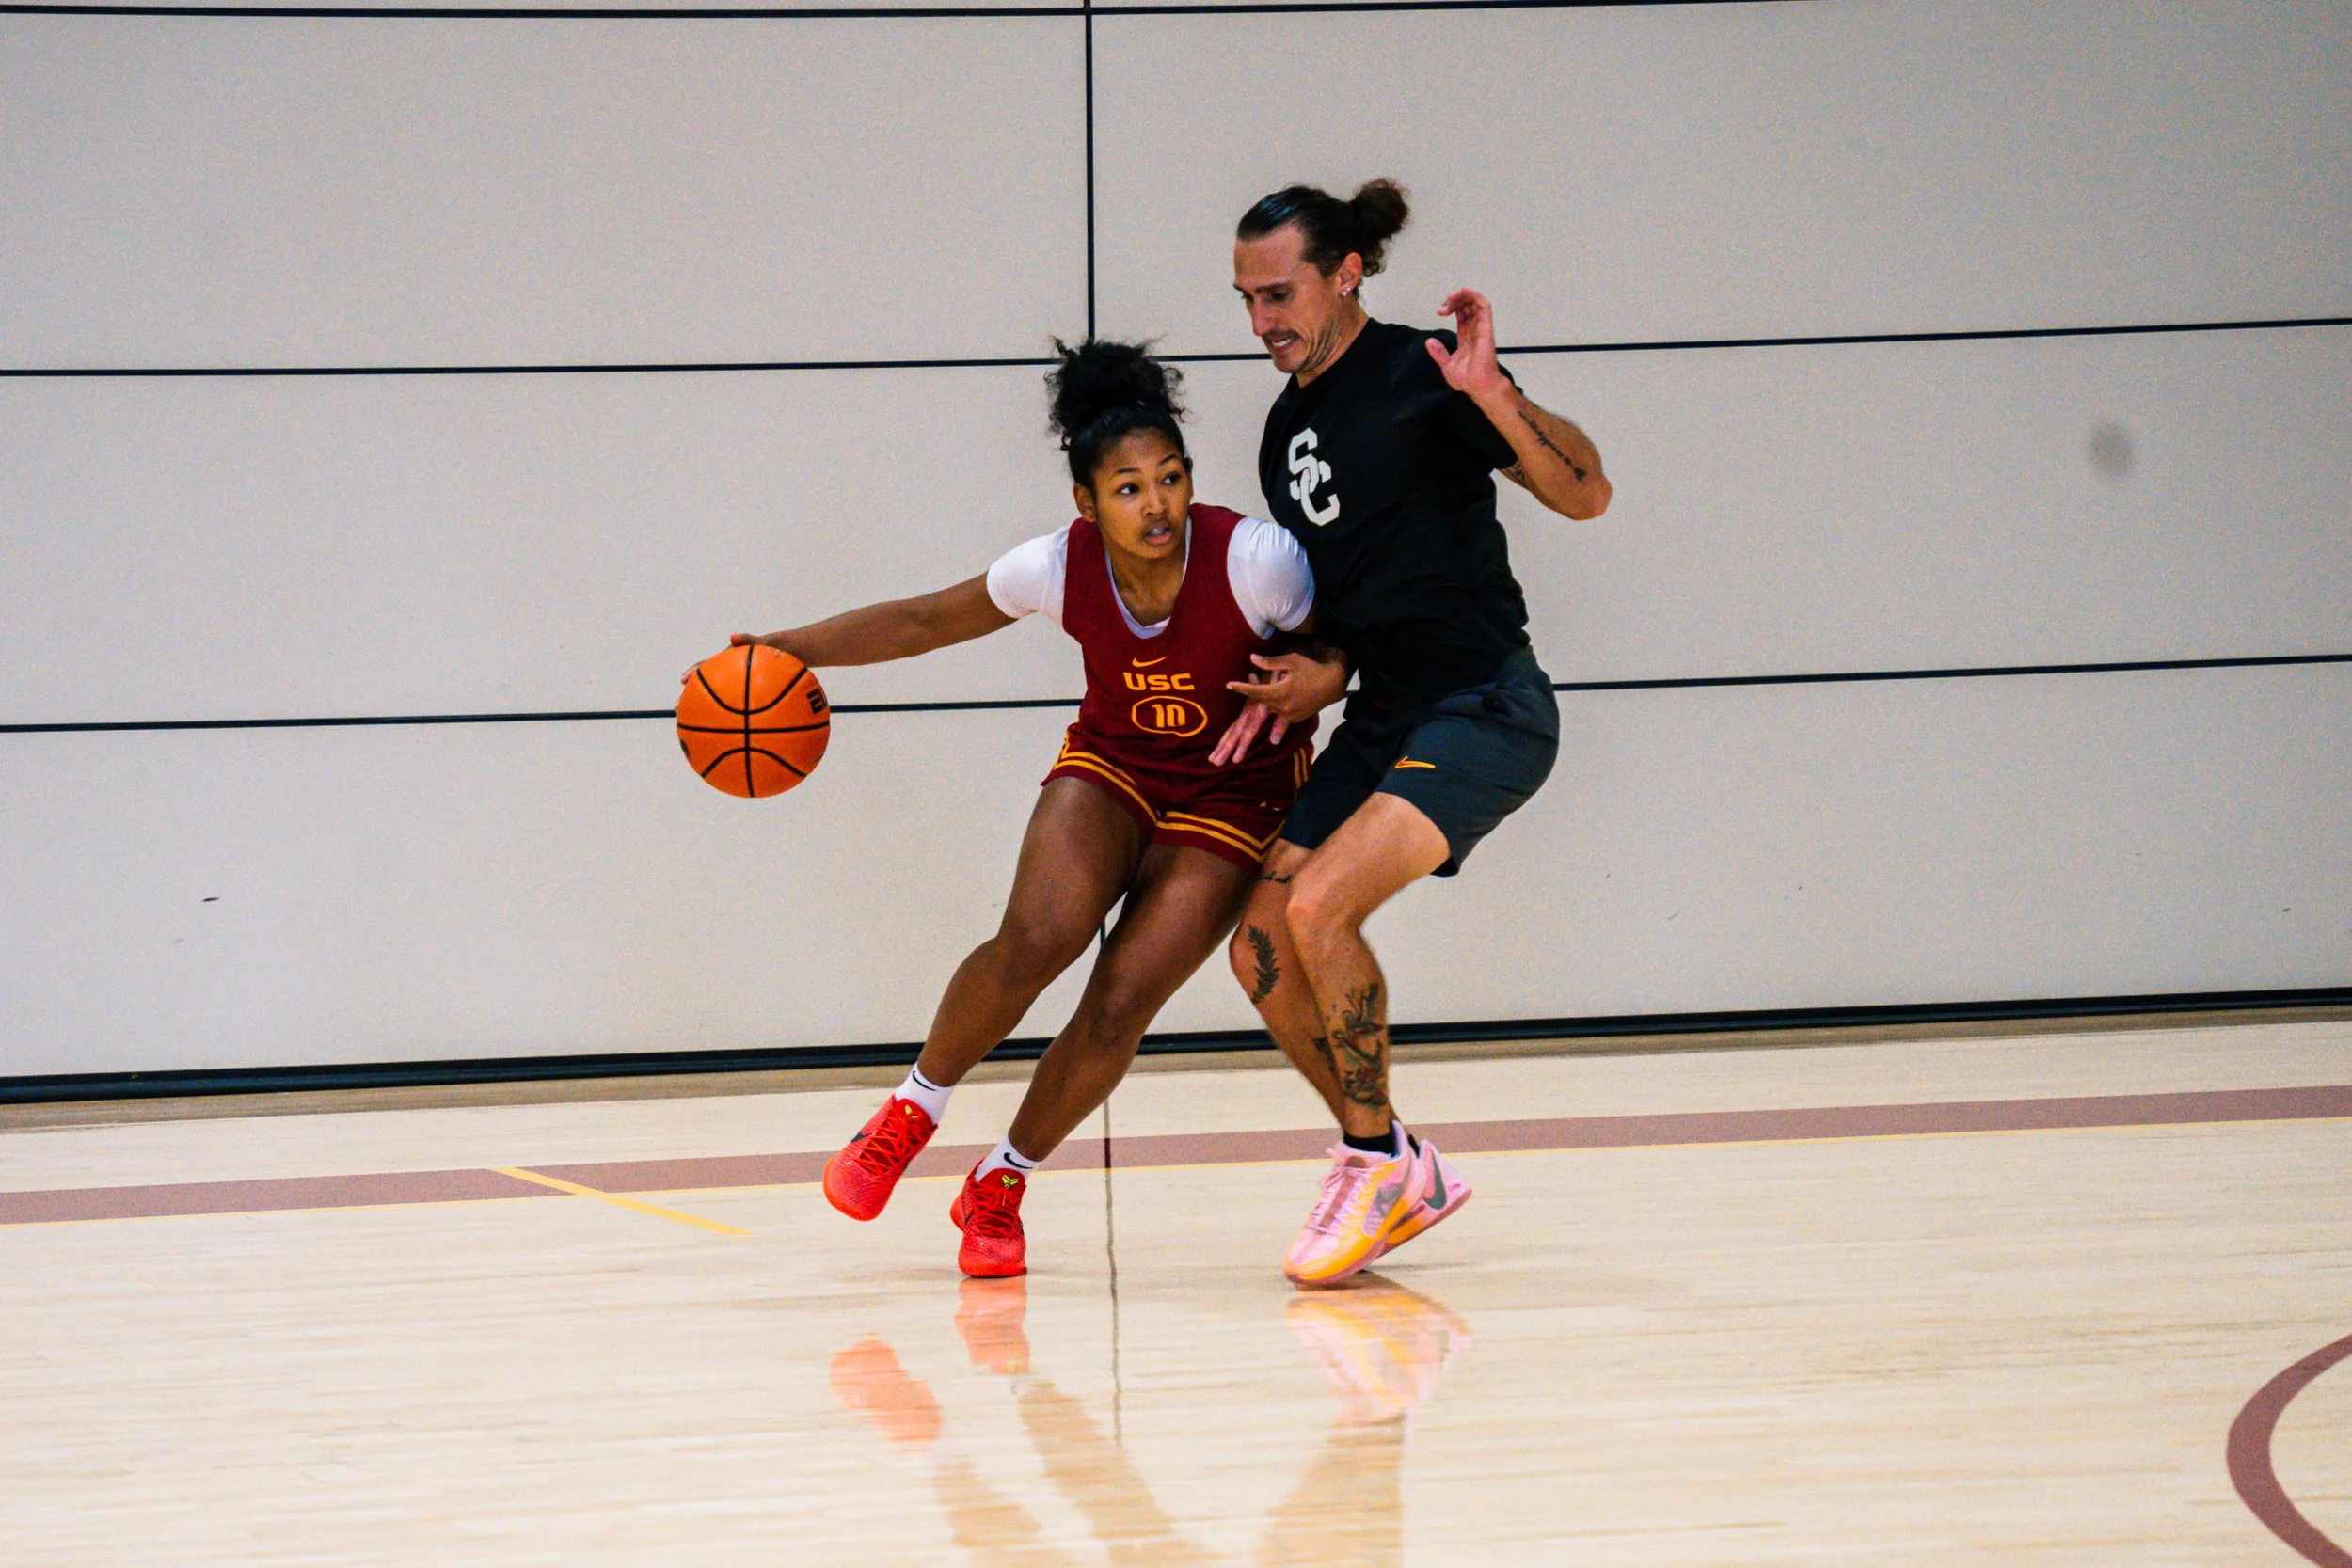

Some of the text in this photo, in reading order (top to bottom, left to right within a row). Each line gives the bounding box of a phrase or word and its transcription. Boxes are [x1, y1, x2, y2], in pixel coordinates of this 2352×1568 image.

[1288, 427, 1341, 527] SC
[1122, 672, 1195, 691] USC
[1152, 704, 1186, 728] 10
